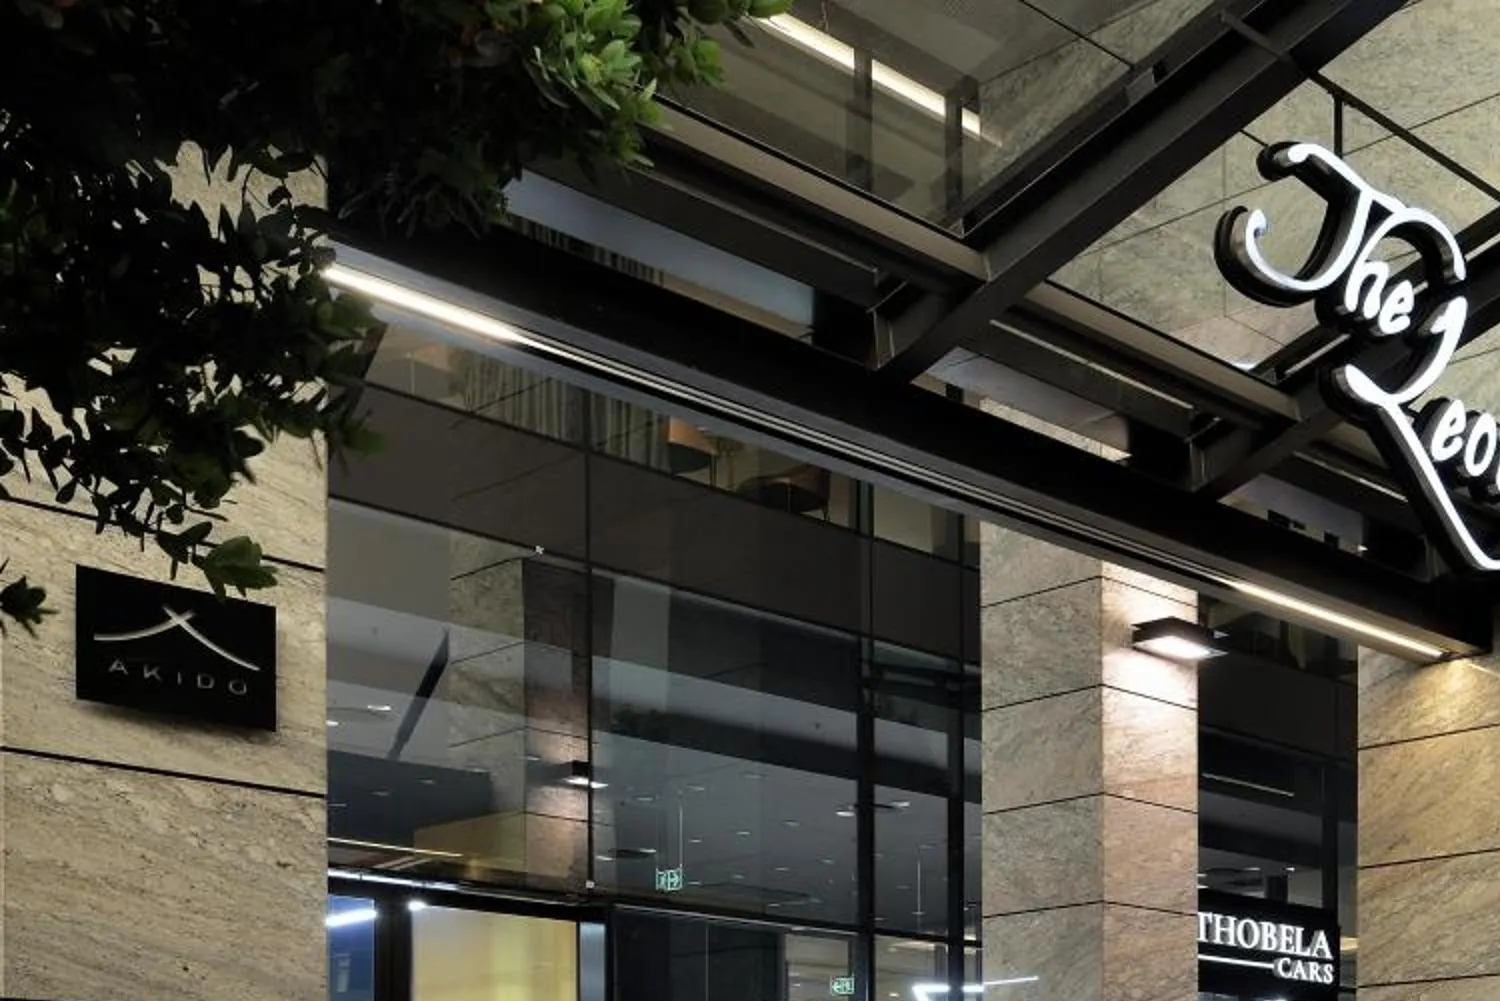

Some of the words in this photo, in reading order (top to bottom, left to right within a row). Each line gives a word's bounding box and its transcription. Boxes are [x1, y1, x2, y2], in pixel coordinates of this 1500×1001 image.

[1238, 142, 1466, 335] The
[108, 657, 248, 695] AKIDO
[1197, 911, 1334, 960] THOBELA
[1275, 957, 1333, 984] CARS
